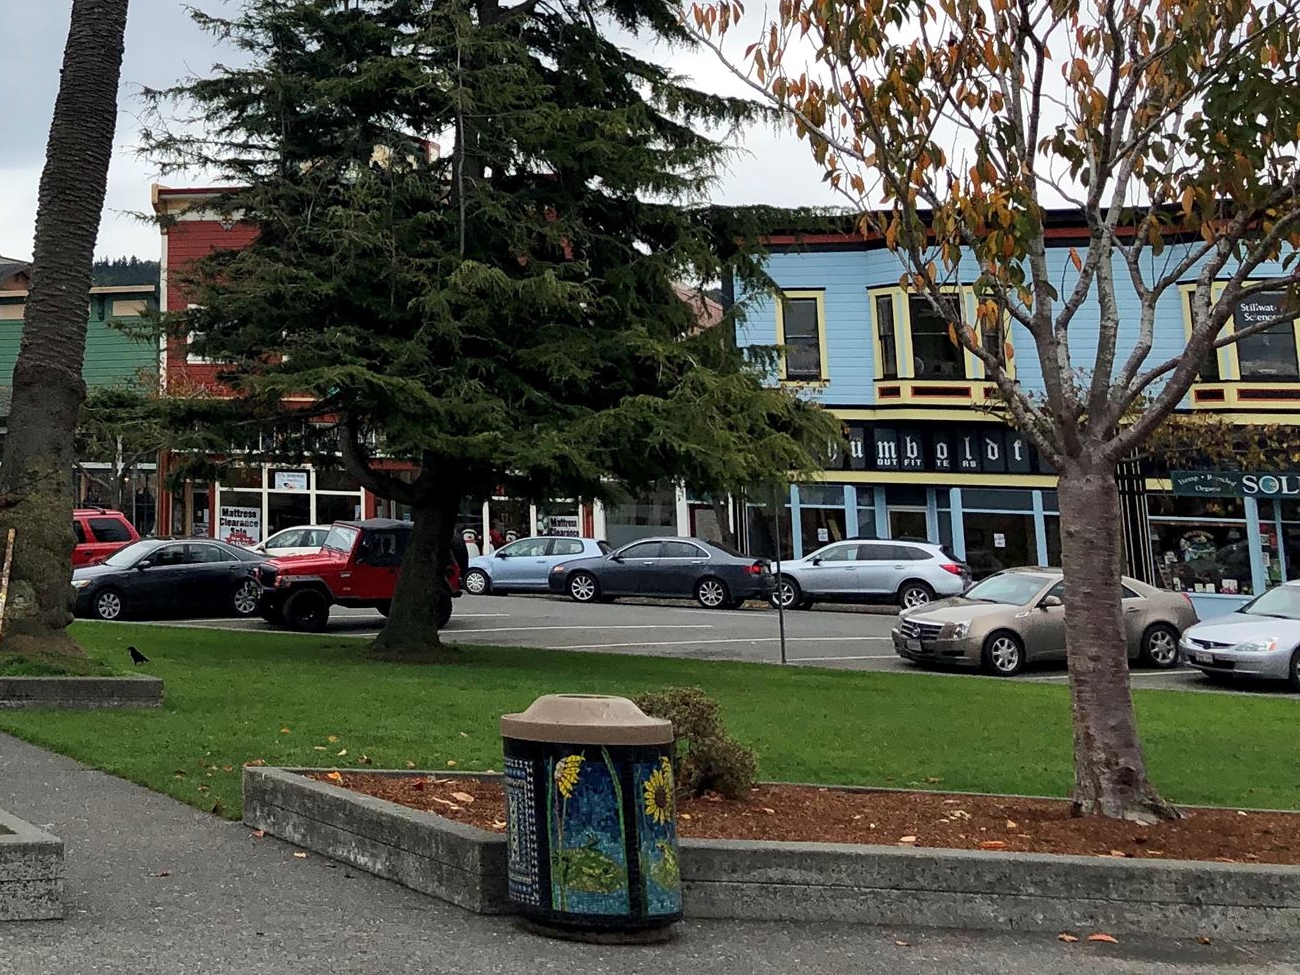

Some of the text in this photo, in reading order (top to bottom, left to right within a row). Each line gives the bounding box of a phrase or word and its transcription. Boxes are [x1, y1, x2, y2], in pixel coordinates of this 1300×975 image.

[1241, 302, 1277, 312] Stillwat
[1241, 474, 1300, 494] SOL
[221, 507, 257, 518] Mattress
[219, 517, 259, 527] Clearance
